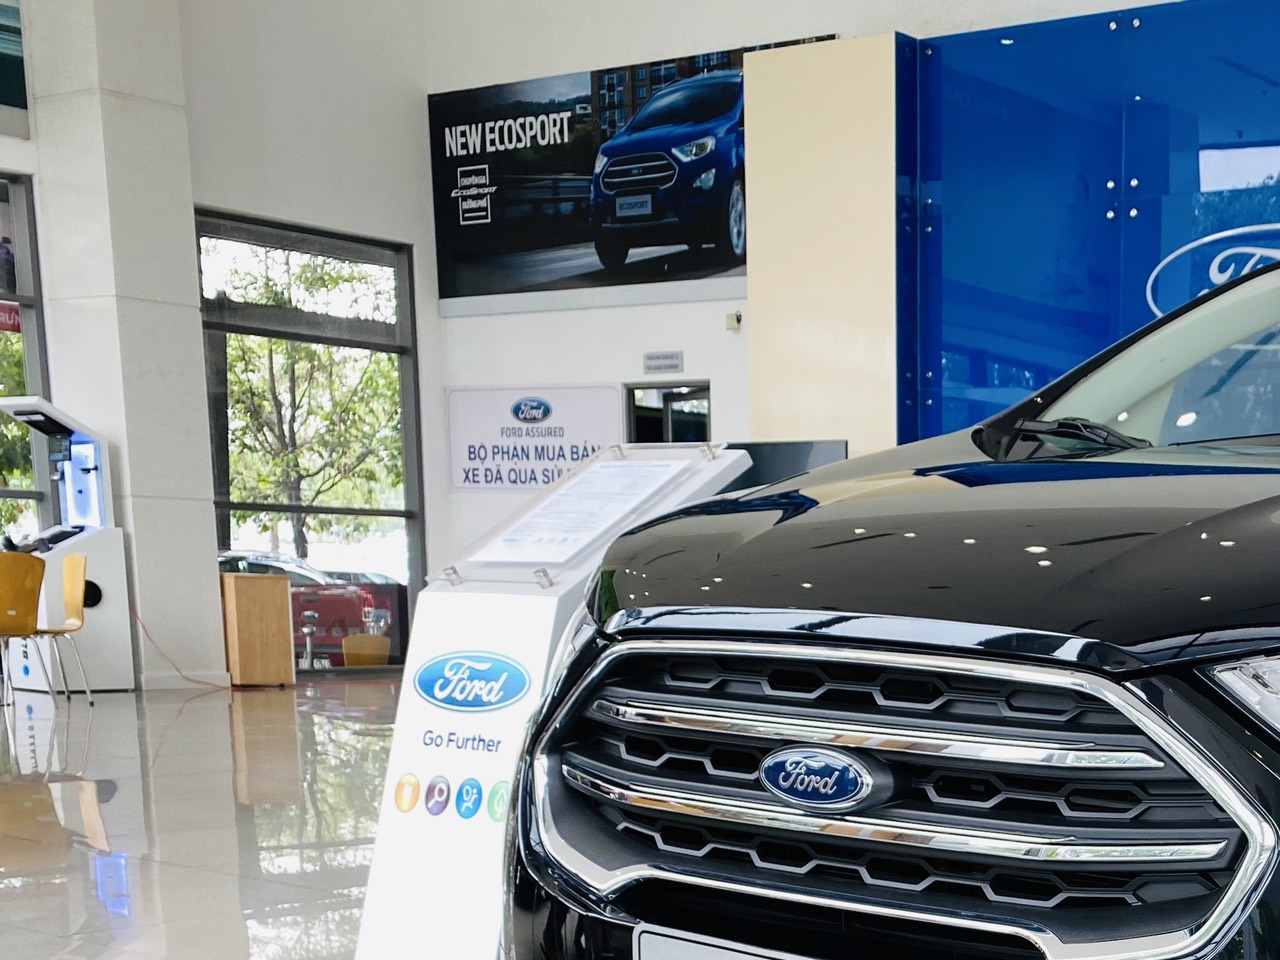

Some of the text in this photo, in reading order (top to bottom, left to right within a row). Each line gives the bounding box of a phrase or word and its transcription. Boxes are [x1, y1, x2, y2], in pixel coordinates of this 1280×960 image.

[444, 111, 572, 158] NEW ECOSPORT
[518, 401, 544, 420] Ford
[500, 426, 565, 438] FORD ASSURED
[468, 443, 487, 465] BỘ
[492, 443, 530, 465] PHẬN
[534, 444, 566, 462] MUA
[463, 467, 480, 484] XE
[484, 463, 503, 484] ĐÃ
[507, 467, 538, 486] QUA
[433, 658, 508, 703] Ford
[423, 729, 502, 753] Go Further
[778, 756, 840, 795] Ford
